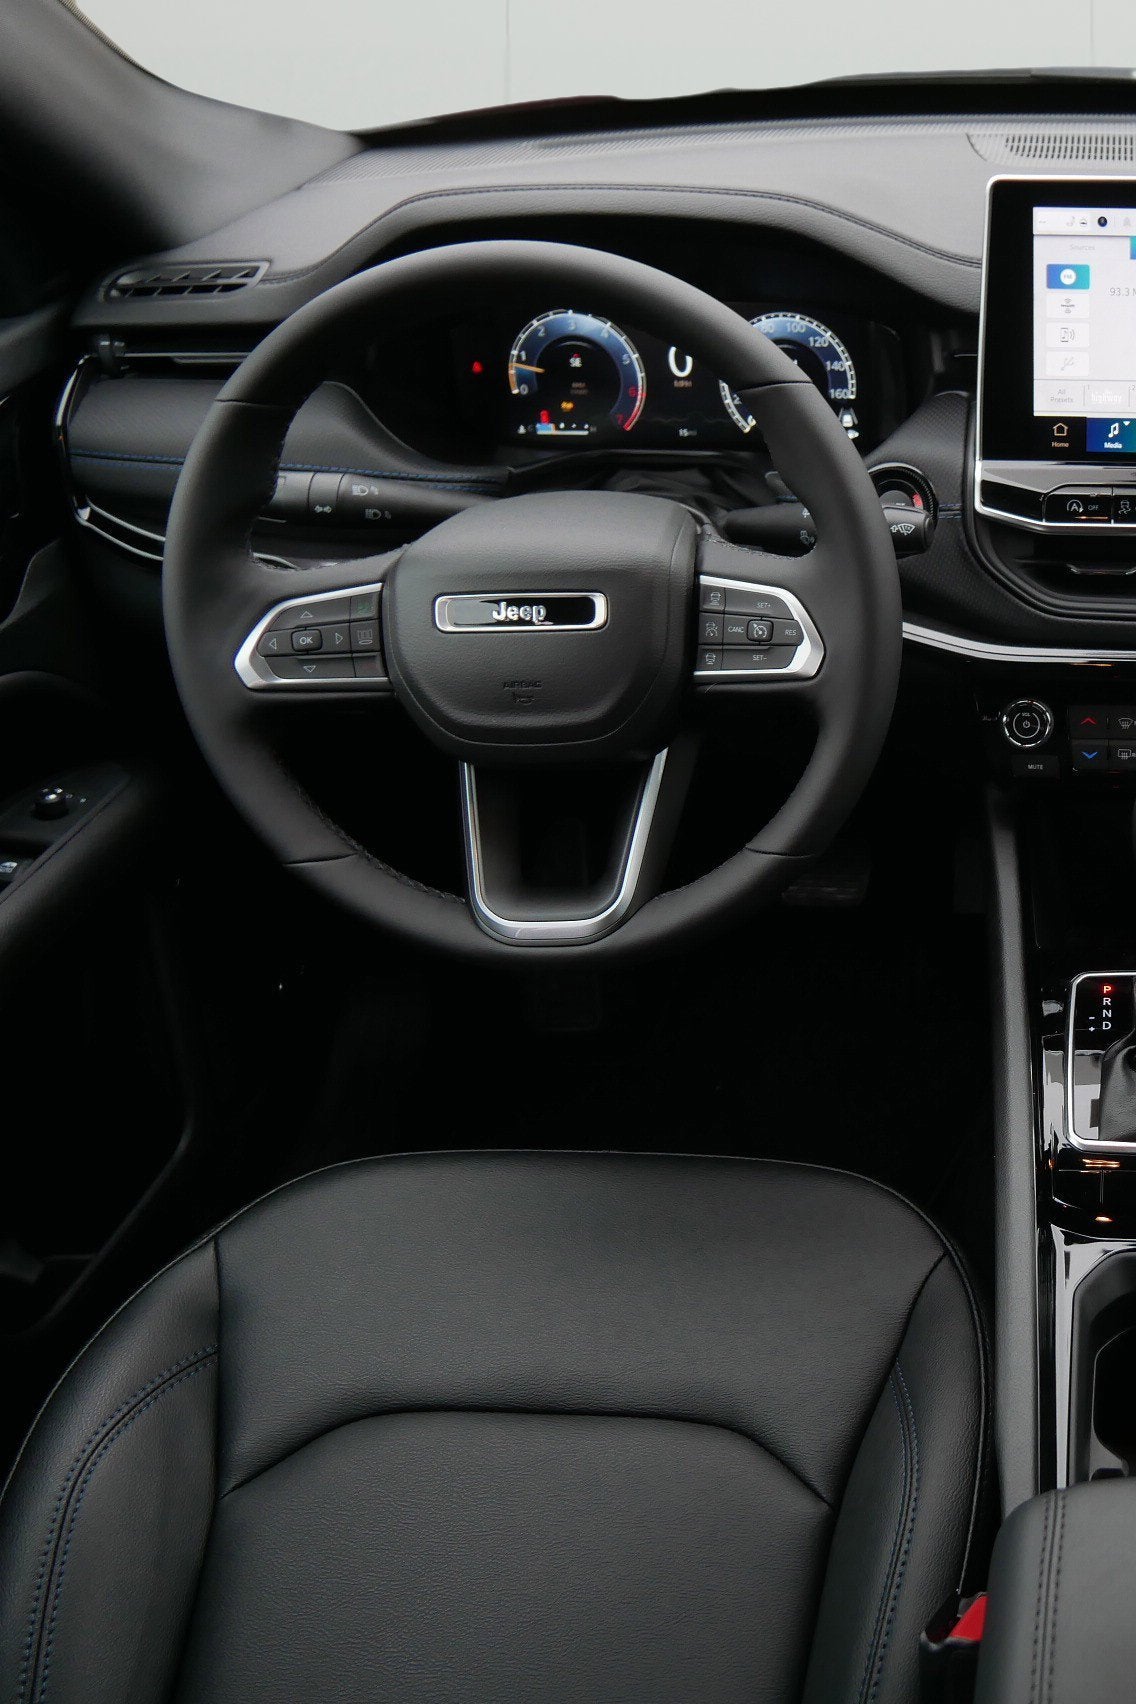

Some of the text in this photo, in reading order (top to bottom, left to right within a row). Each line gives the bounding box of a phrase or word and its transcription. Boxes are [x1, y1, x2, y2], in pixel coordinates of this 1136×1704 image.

[1109, 287, 1130, 297] 93.3
[539, 325, 546, 337] 2
[786, 322, 806, 333] 100
[808, 337, 829, 347] 120
[826, 361, 845, 371] 140
[519, 384, 529, 395] 0
[829, 389, 849, 399] 160
[492, 601, 547, 623] Jeep
[299, 635, 313, 645] OK
[1103, 985, 1112, 994] P
[1102, 997, 1112, 1006] R
[1102, 1009, 1112, 1018] N
[1102, 1021, 1112, 1030] D
